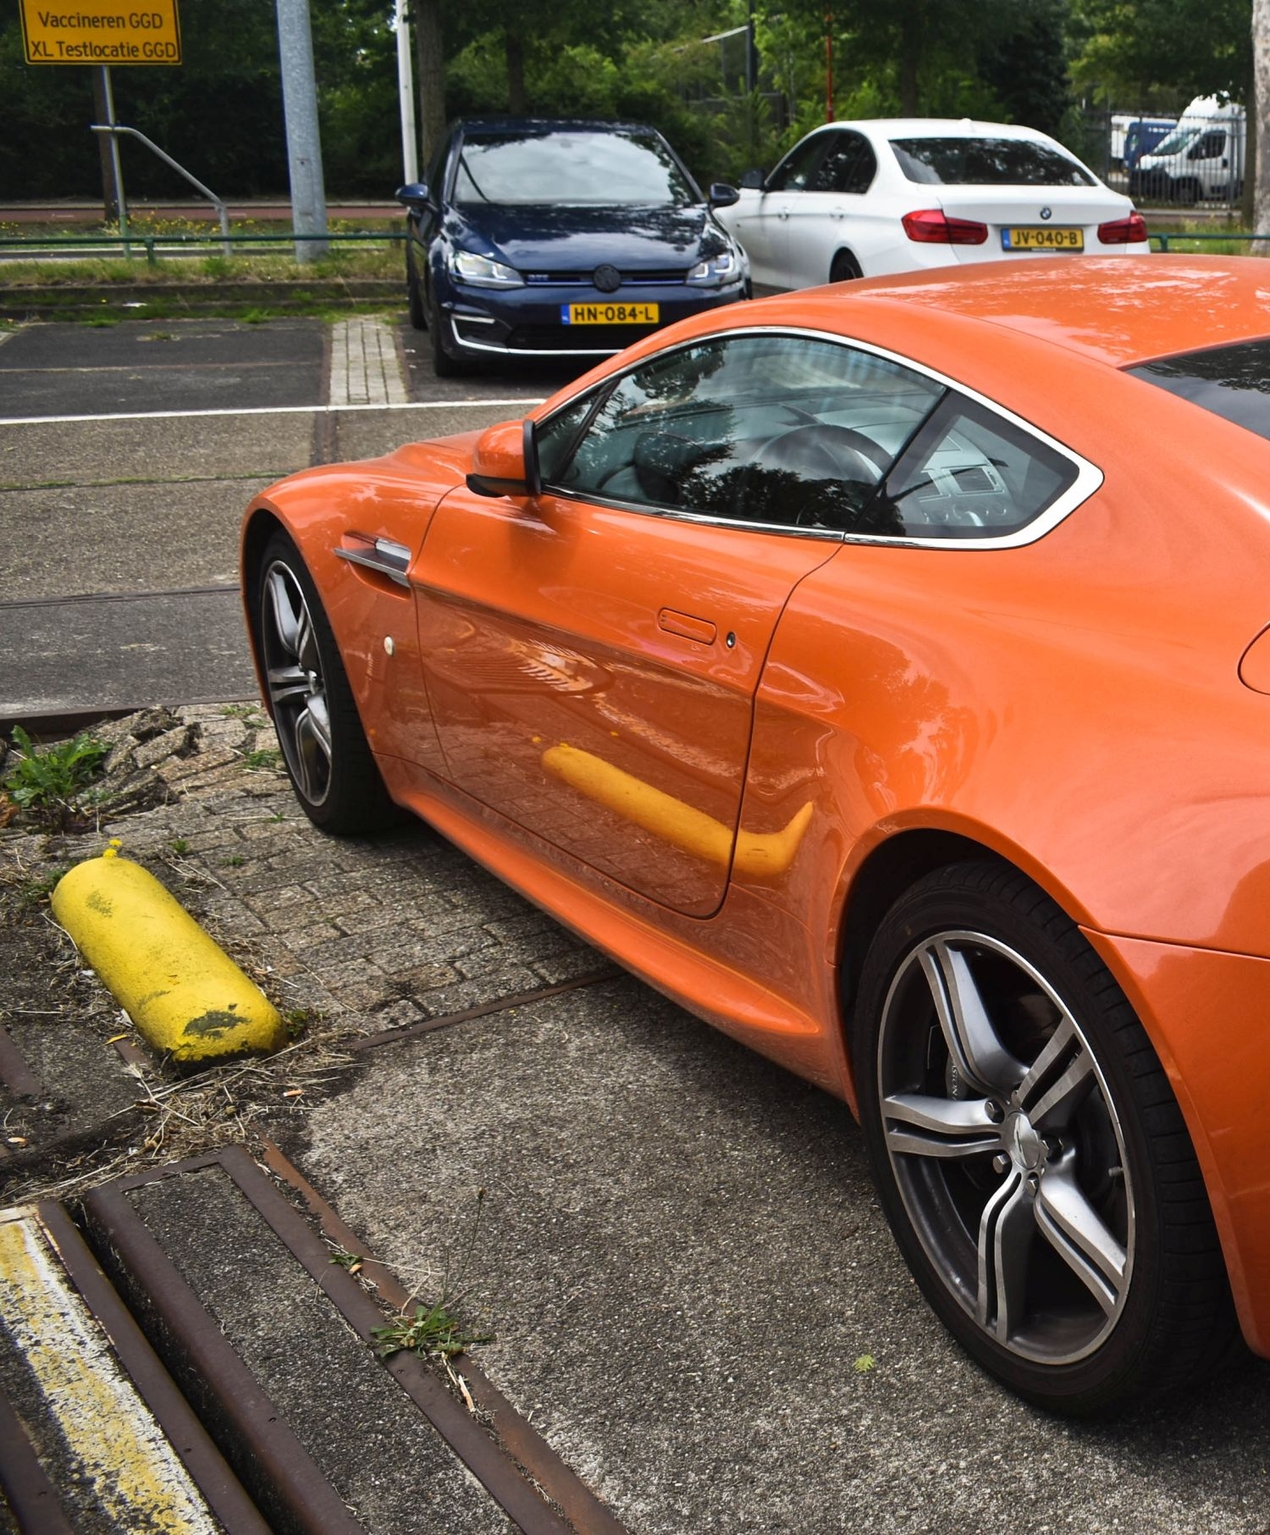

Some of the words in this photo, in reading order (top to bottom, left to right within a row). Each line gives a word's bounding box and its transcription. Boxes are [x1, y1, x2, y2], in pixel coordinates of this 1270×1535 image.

[38, 12, 125, 28] Vaccineren
[129, 13, 163, 29] GGD
[31, 41, 54, 57] XL
[56, 41, 139, 57] Testlocatie
[142, 42, 176, 58] GGD
[1014, 231, 1077, 245] JV-040-B
[574, 306, 654, 321] HN-084-L
